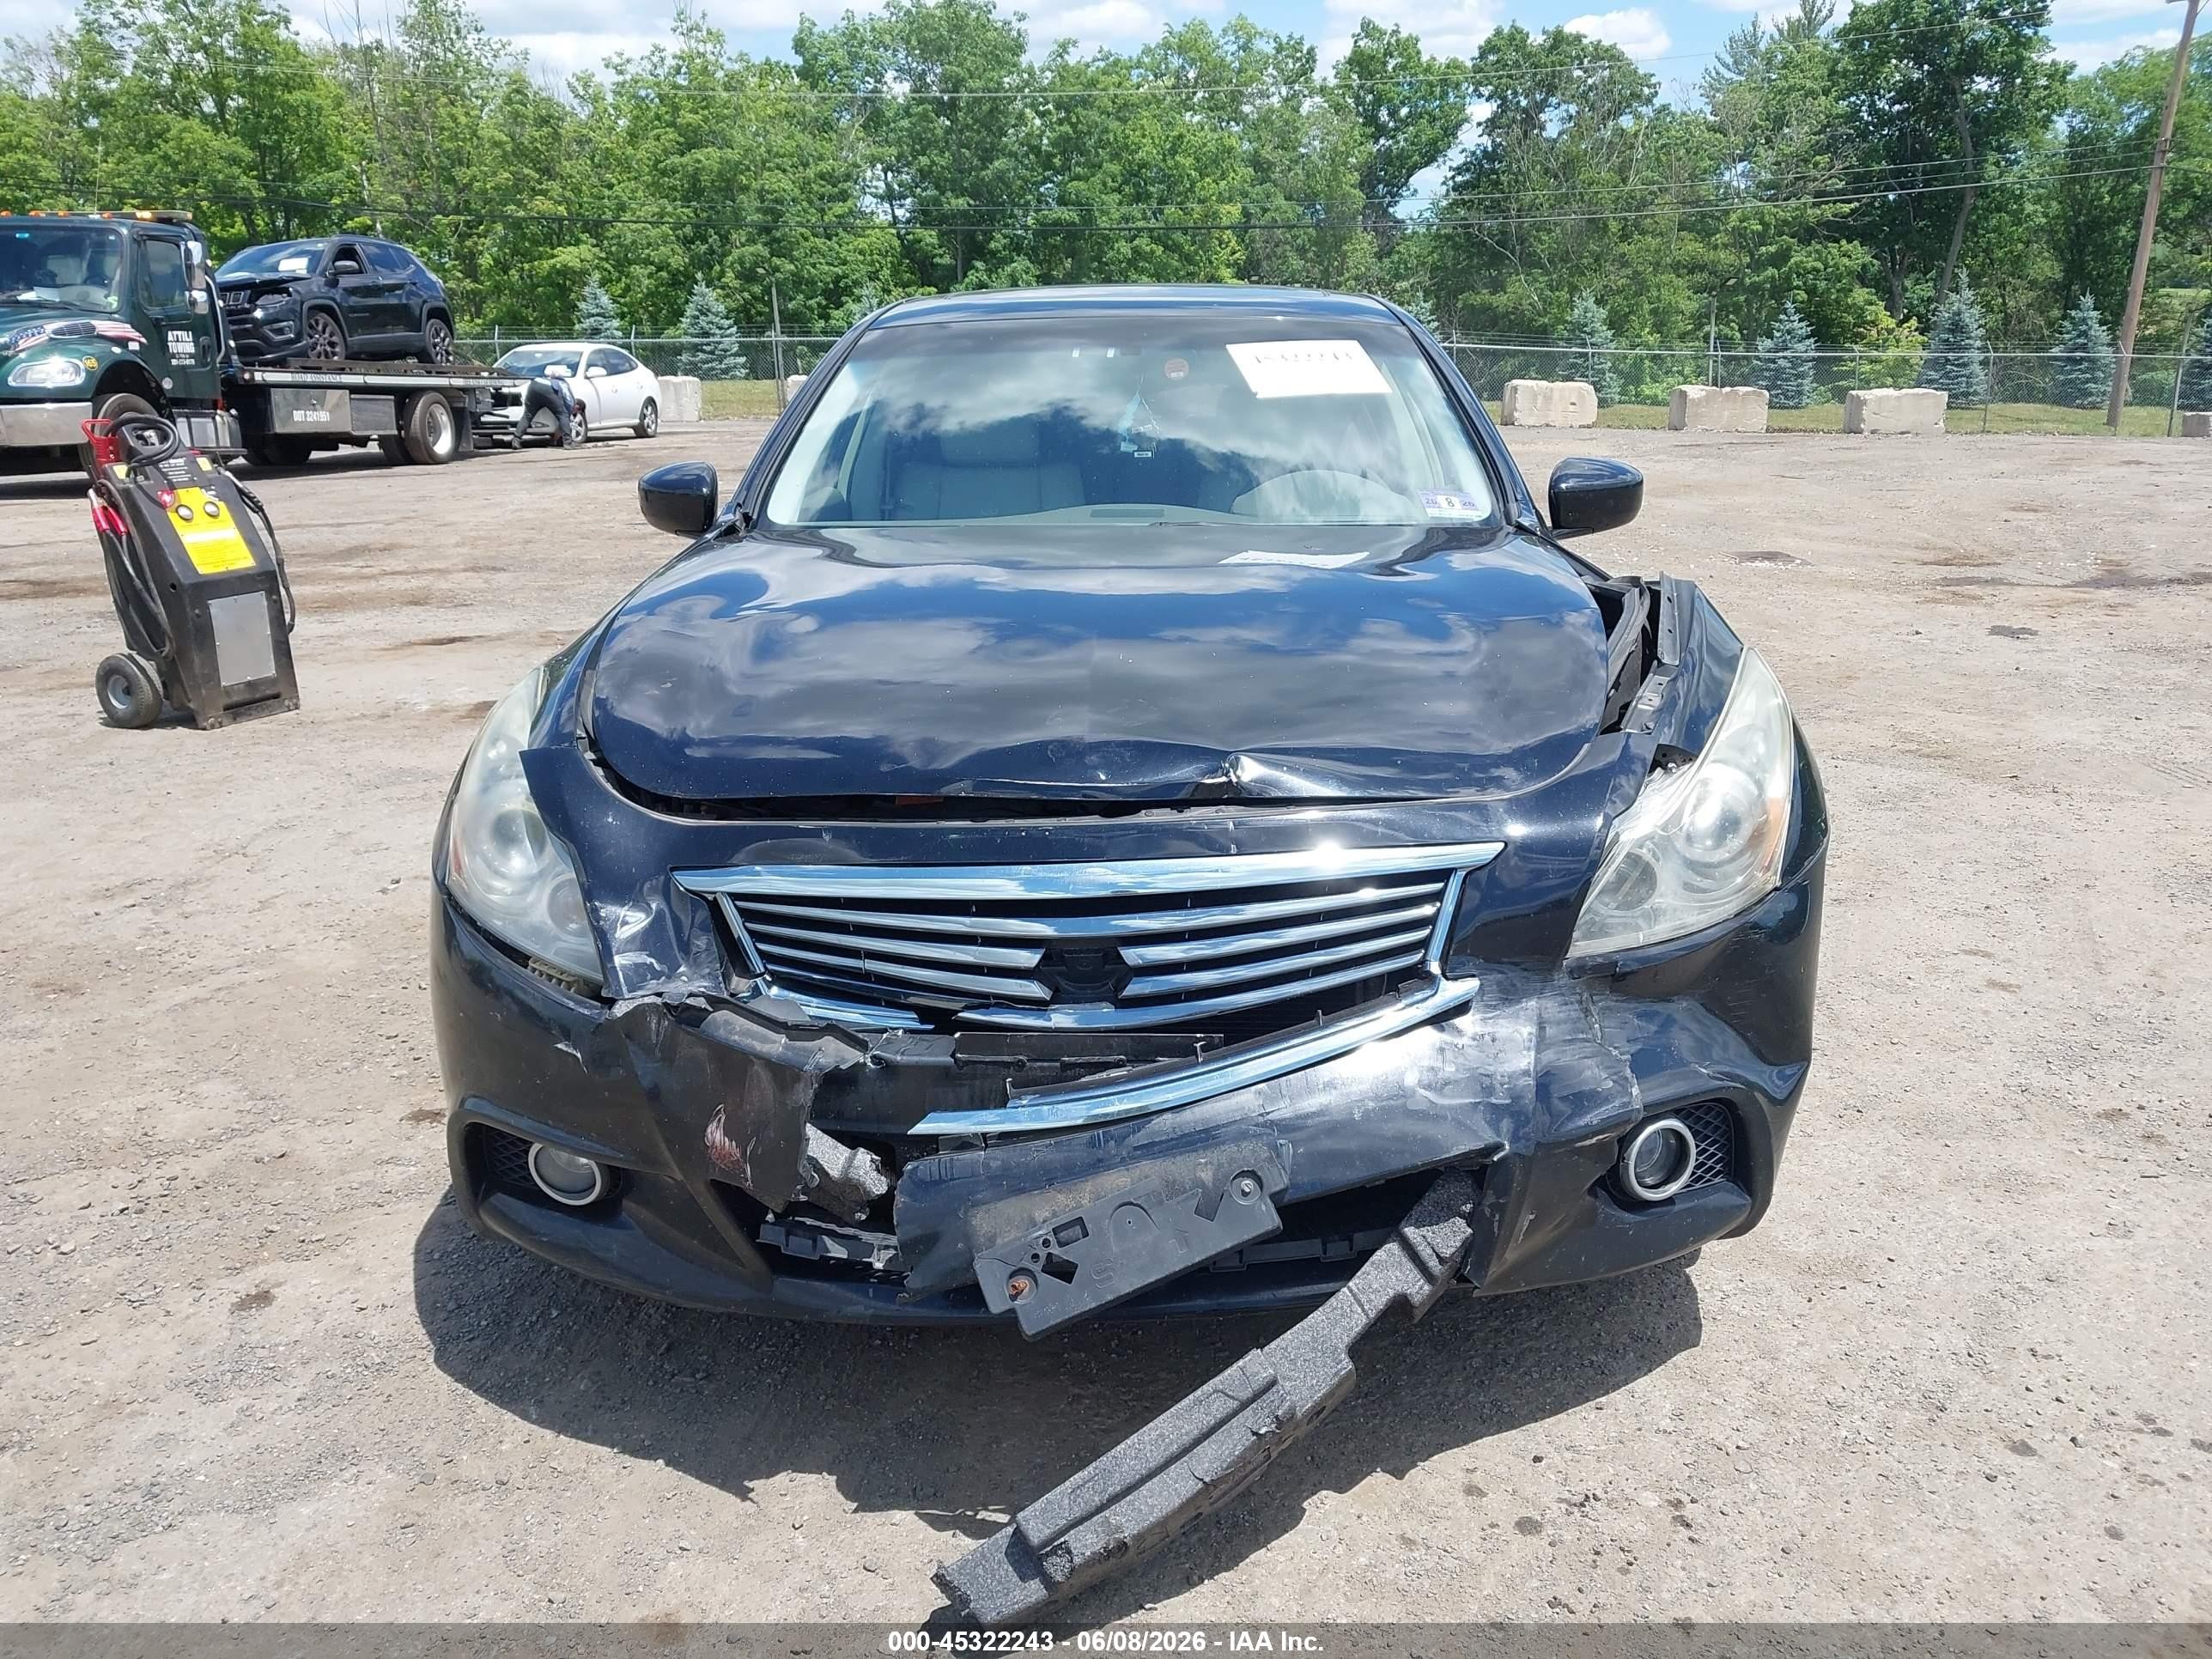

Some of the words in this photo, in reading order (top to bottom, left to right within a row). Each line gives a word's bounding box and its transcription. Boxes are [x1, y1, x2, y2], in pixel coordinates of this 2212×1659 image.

[167, 330, 193, 342] ATTILI
[167, 342, 195, 354] TOWING
[292, 410, 306, 422] DOT
[1445, 497, 1455, 507] 8
